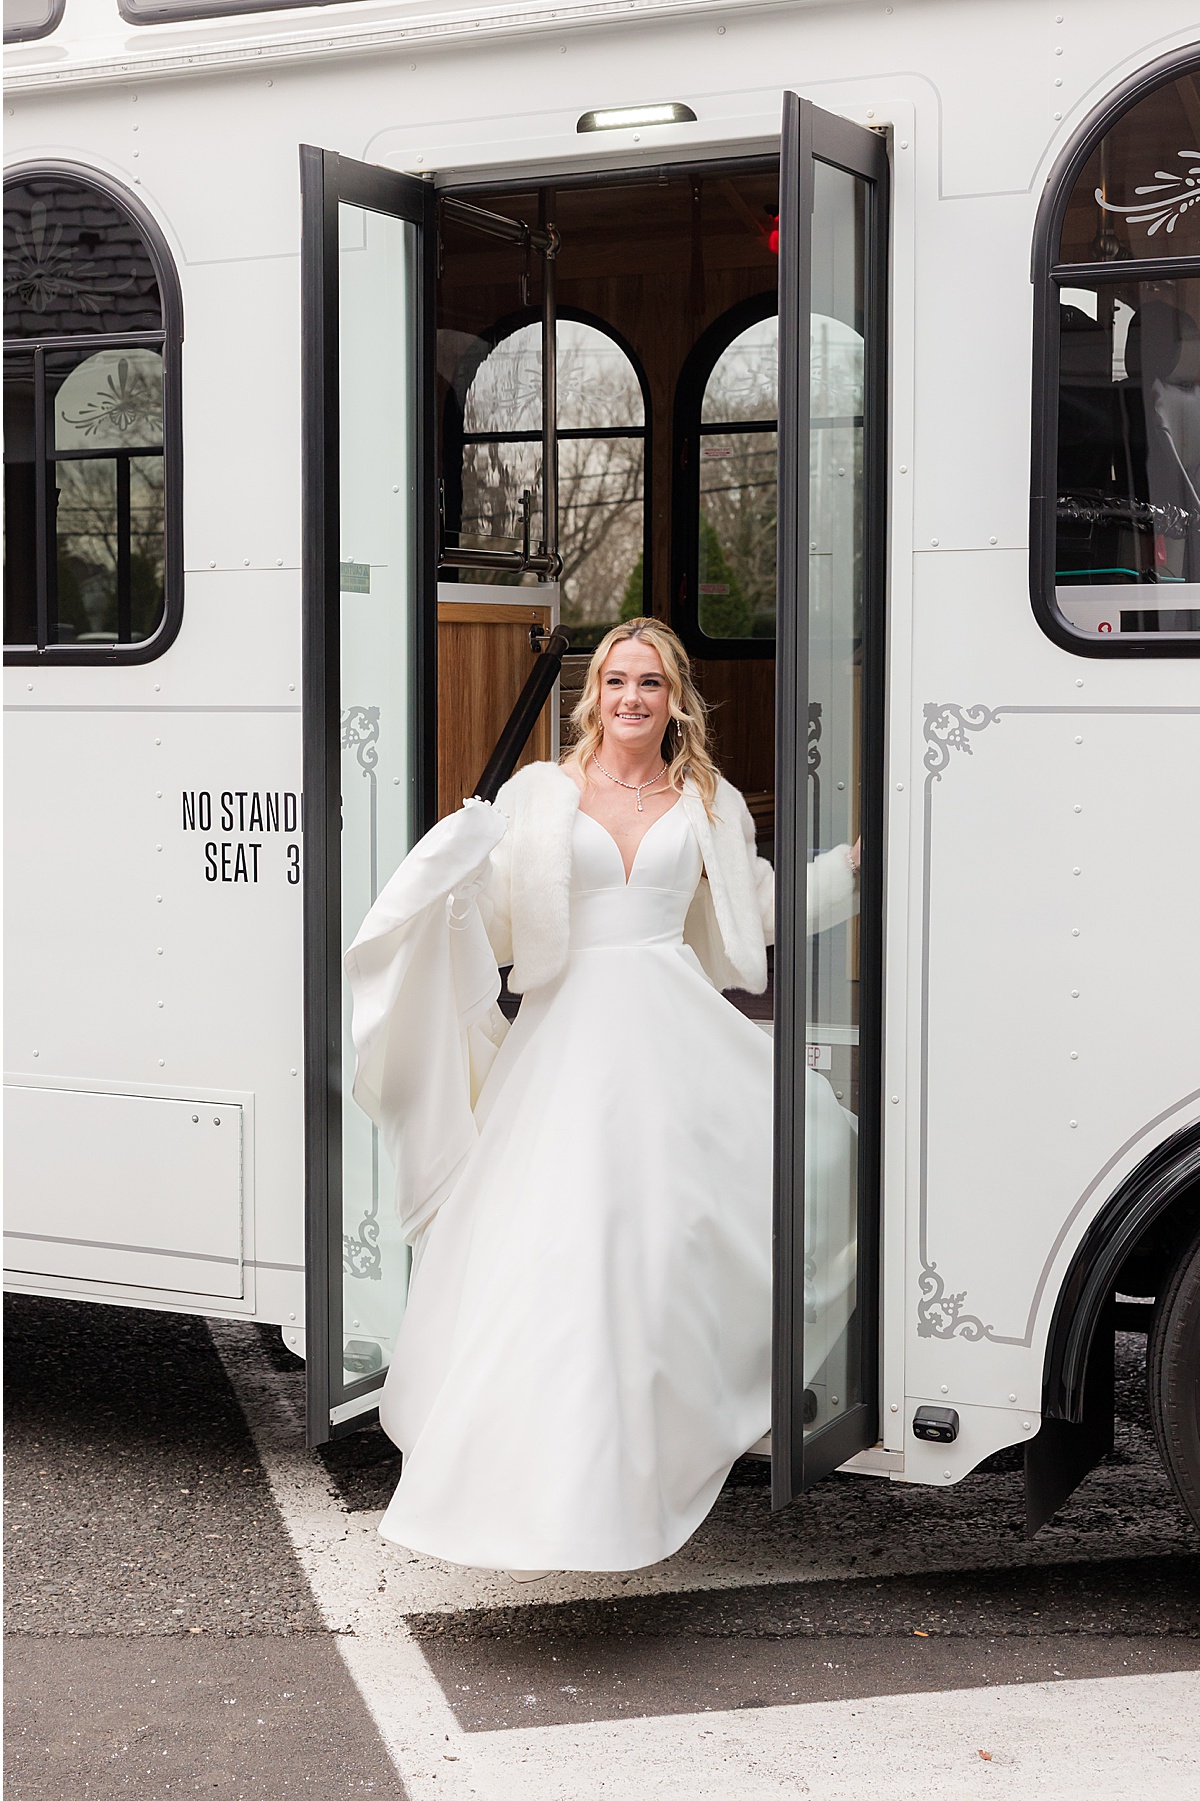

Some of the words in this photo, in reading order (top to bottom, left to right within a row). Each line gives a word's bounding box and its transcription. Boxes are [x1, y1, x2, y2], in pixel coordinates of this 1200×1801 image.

[182, 791, 212, 831] NO
[205, 841, 262, 883] SEAT
[807, 1047, 821, 1067] EP
